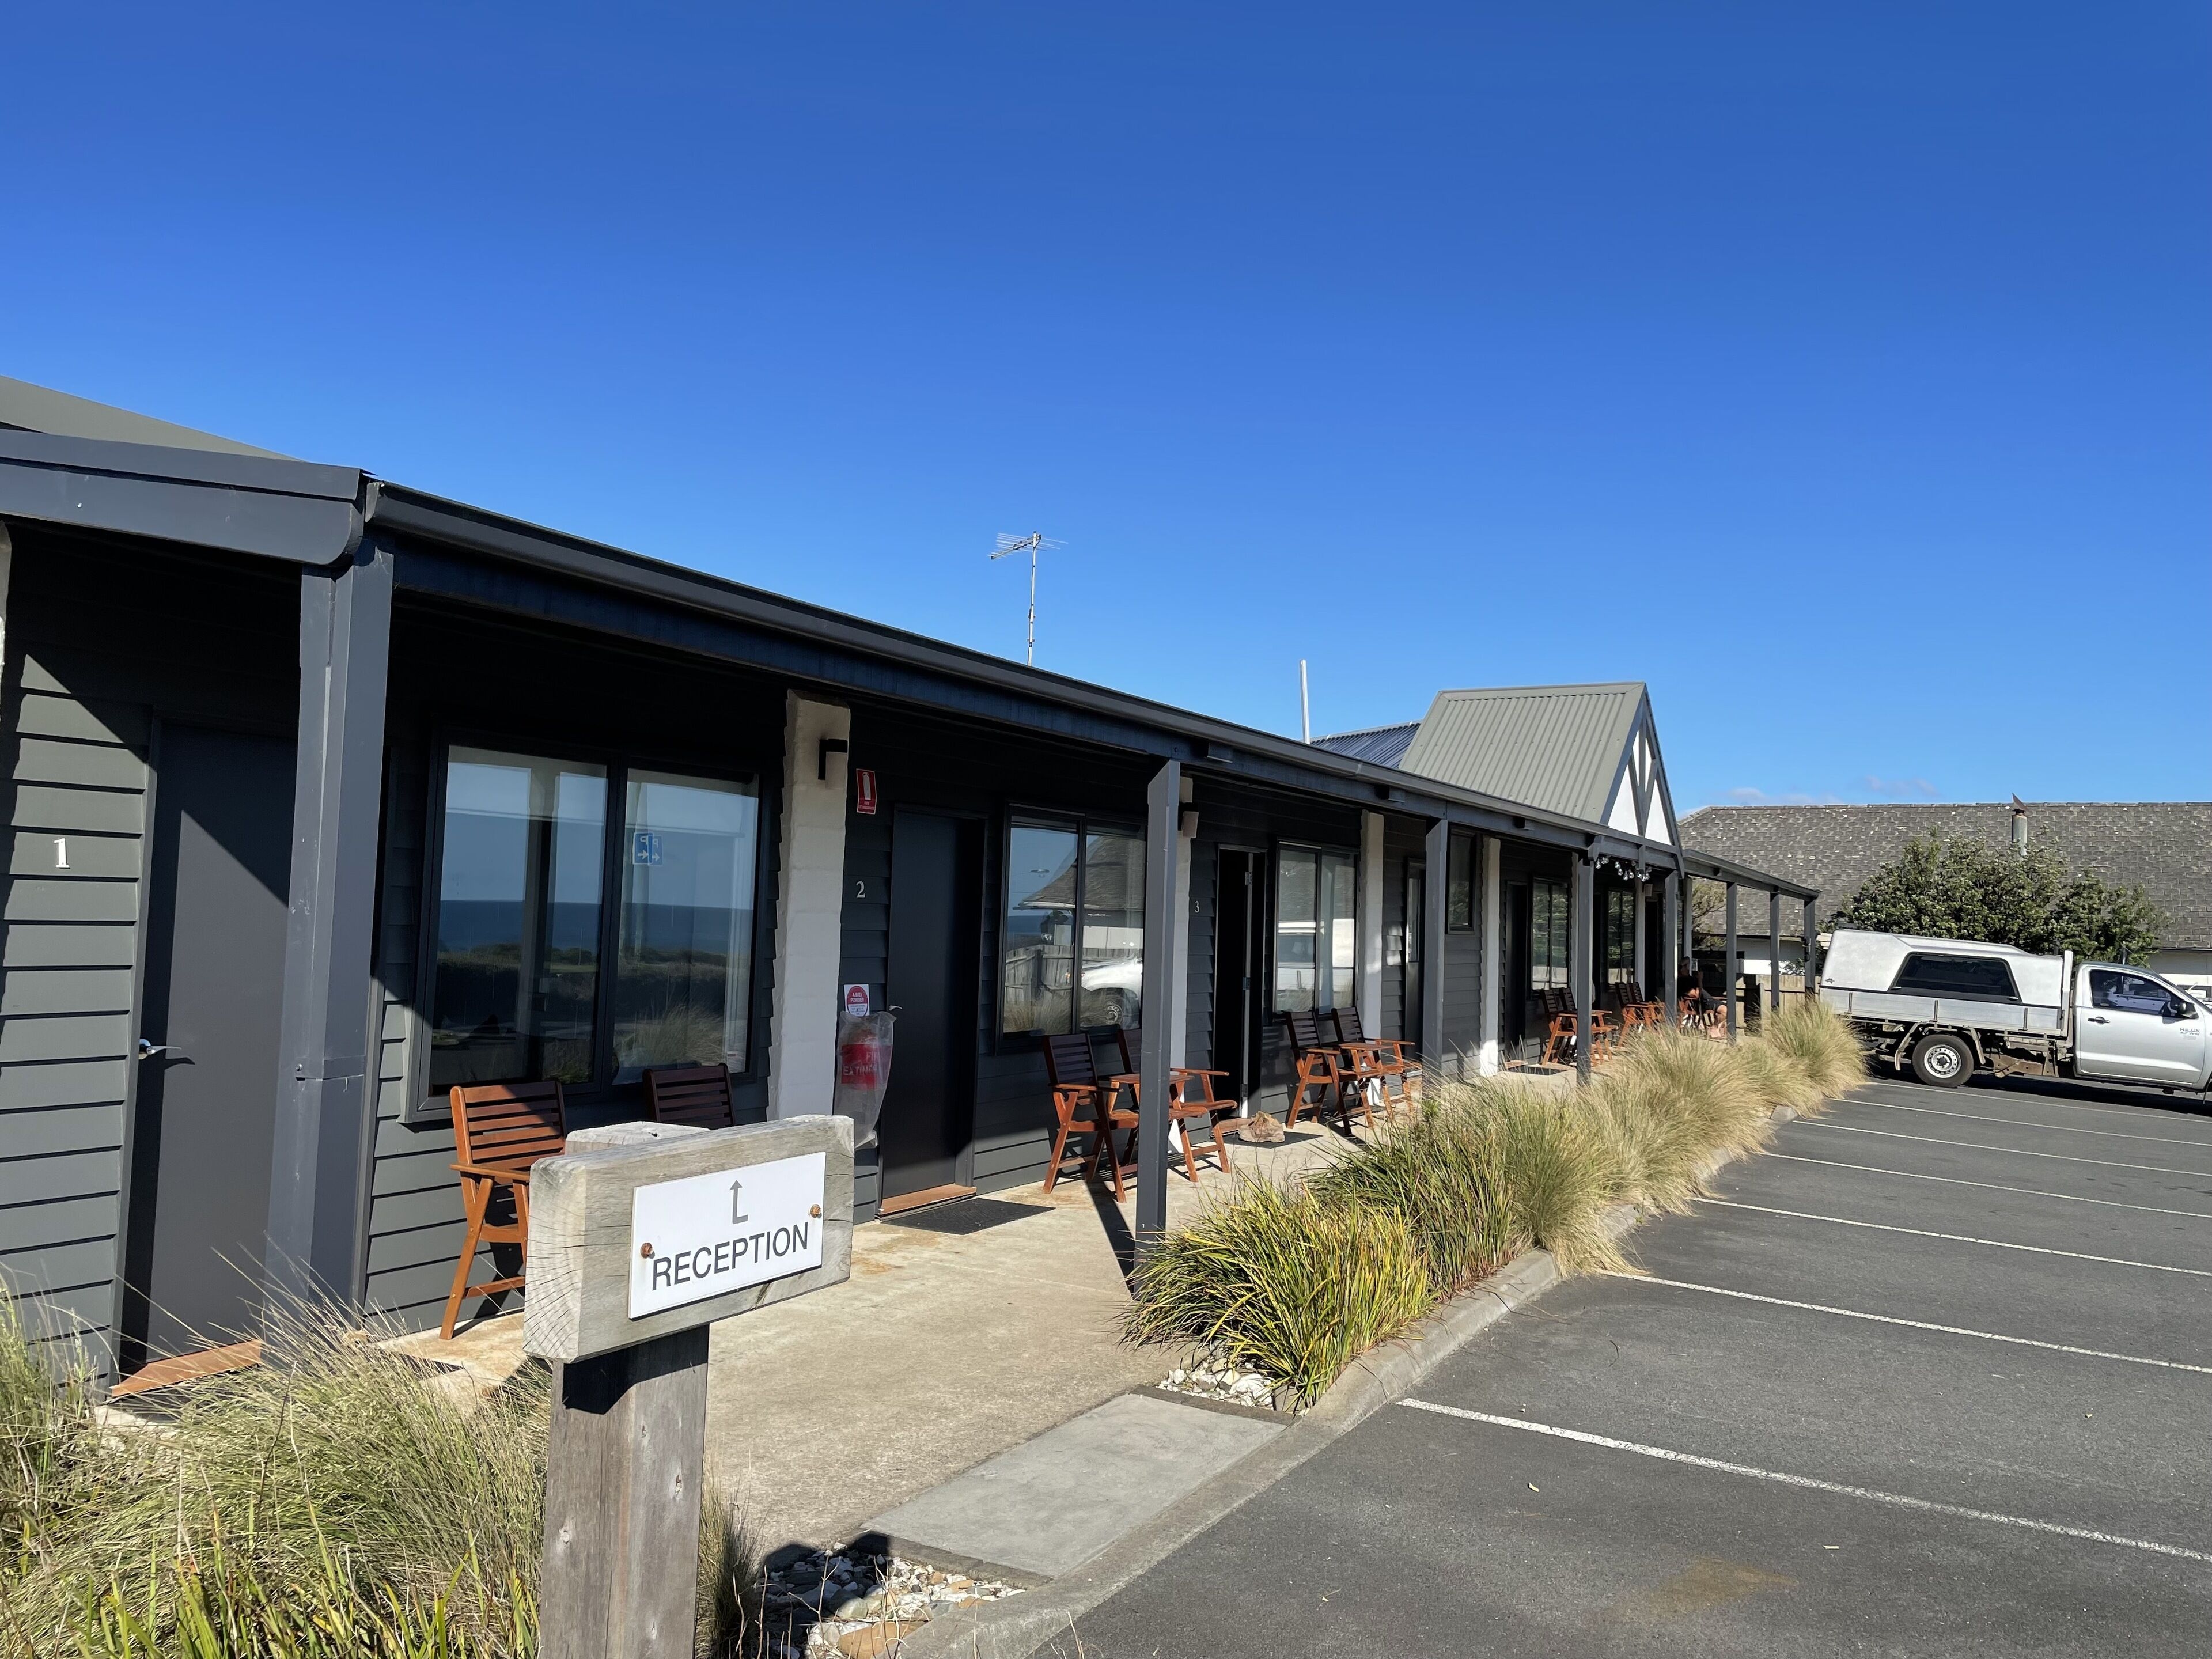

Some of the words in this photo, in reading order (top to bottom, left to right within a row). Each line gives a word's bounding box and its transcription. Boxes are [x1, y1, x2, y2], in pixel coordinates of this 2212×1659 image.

[54, 838, 70, 868] 1
[856, 881, 866, 898] 2
[1195, 900, 1200, 913] 3
[652, 1222, 809, 1290] RECEPTION
